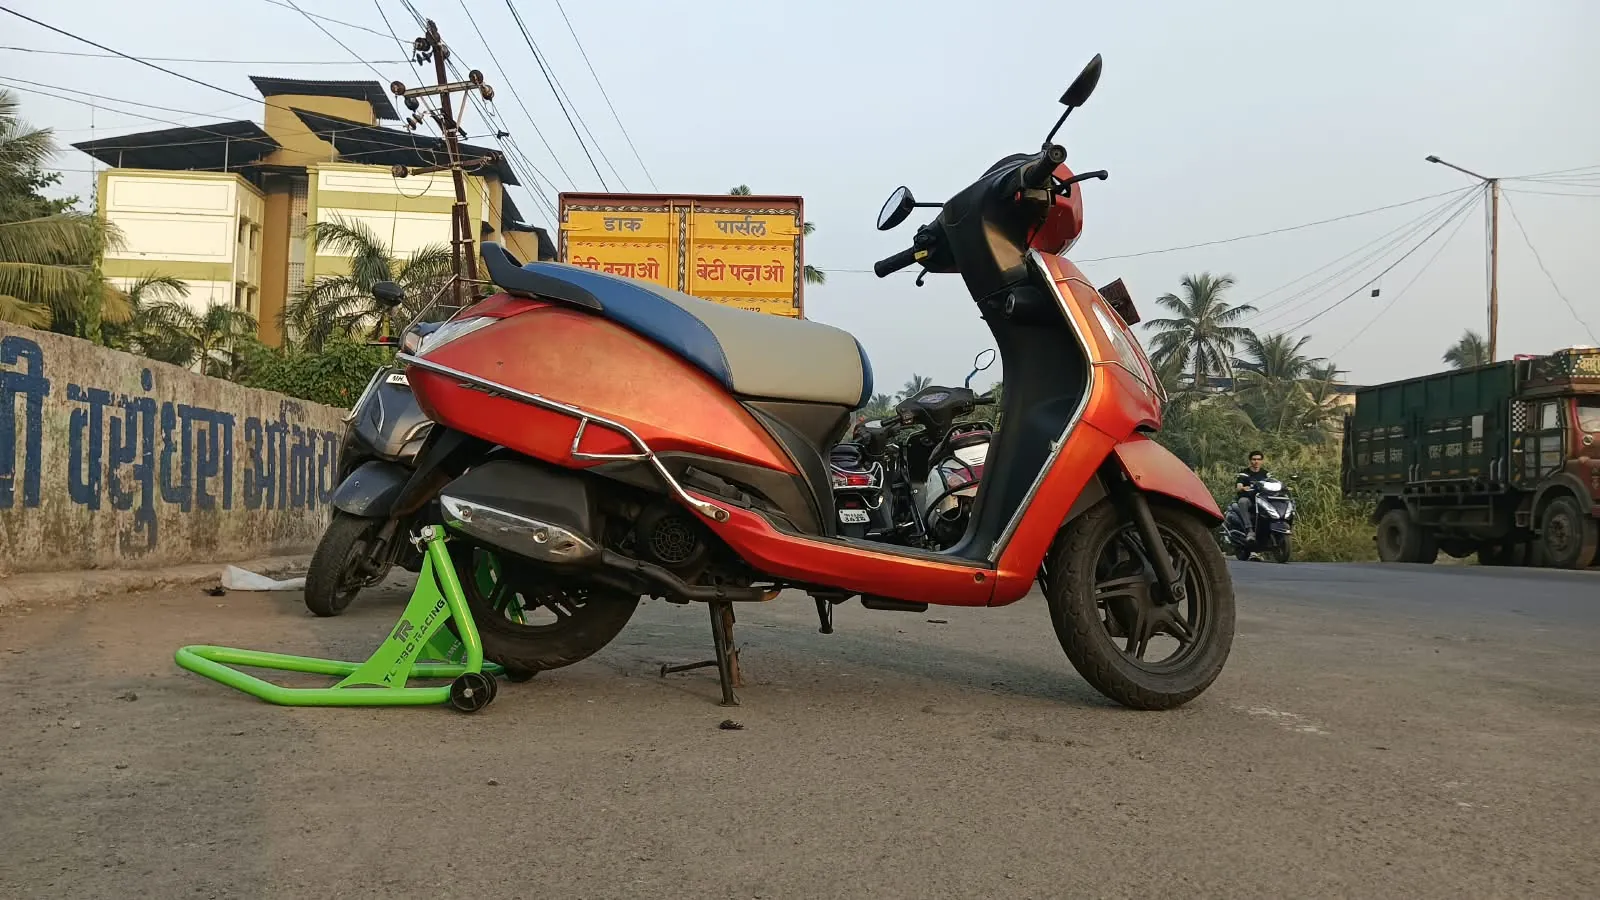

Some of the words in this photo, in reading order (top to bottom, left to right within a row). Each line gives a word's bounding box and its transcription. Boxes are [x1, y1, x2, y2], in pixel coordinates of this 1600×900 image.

[603, 216, 643, 232] डाक
[715, 215, 767, 238] पार्सल
[696, 257, 726, 281] बेटी
[730, 259, 785, 286] पढ़ाओ
